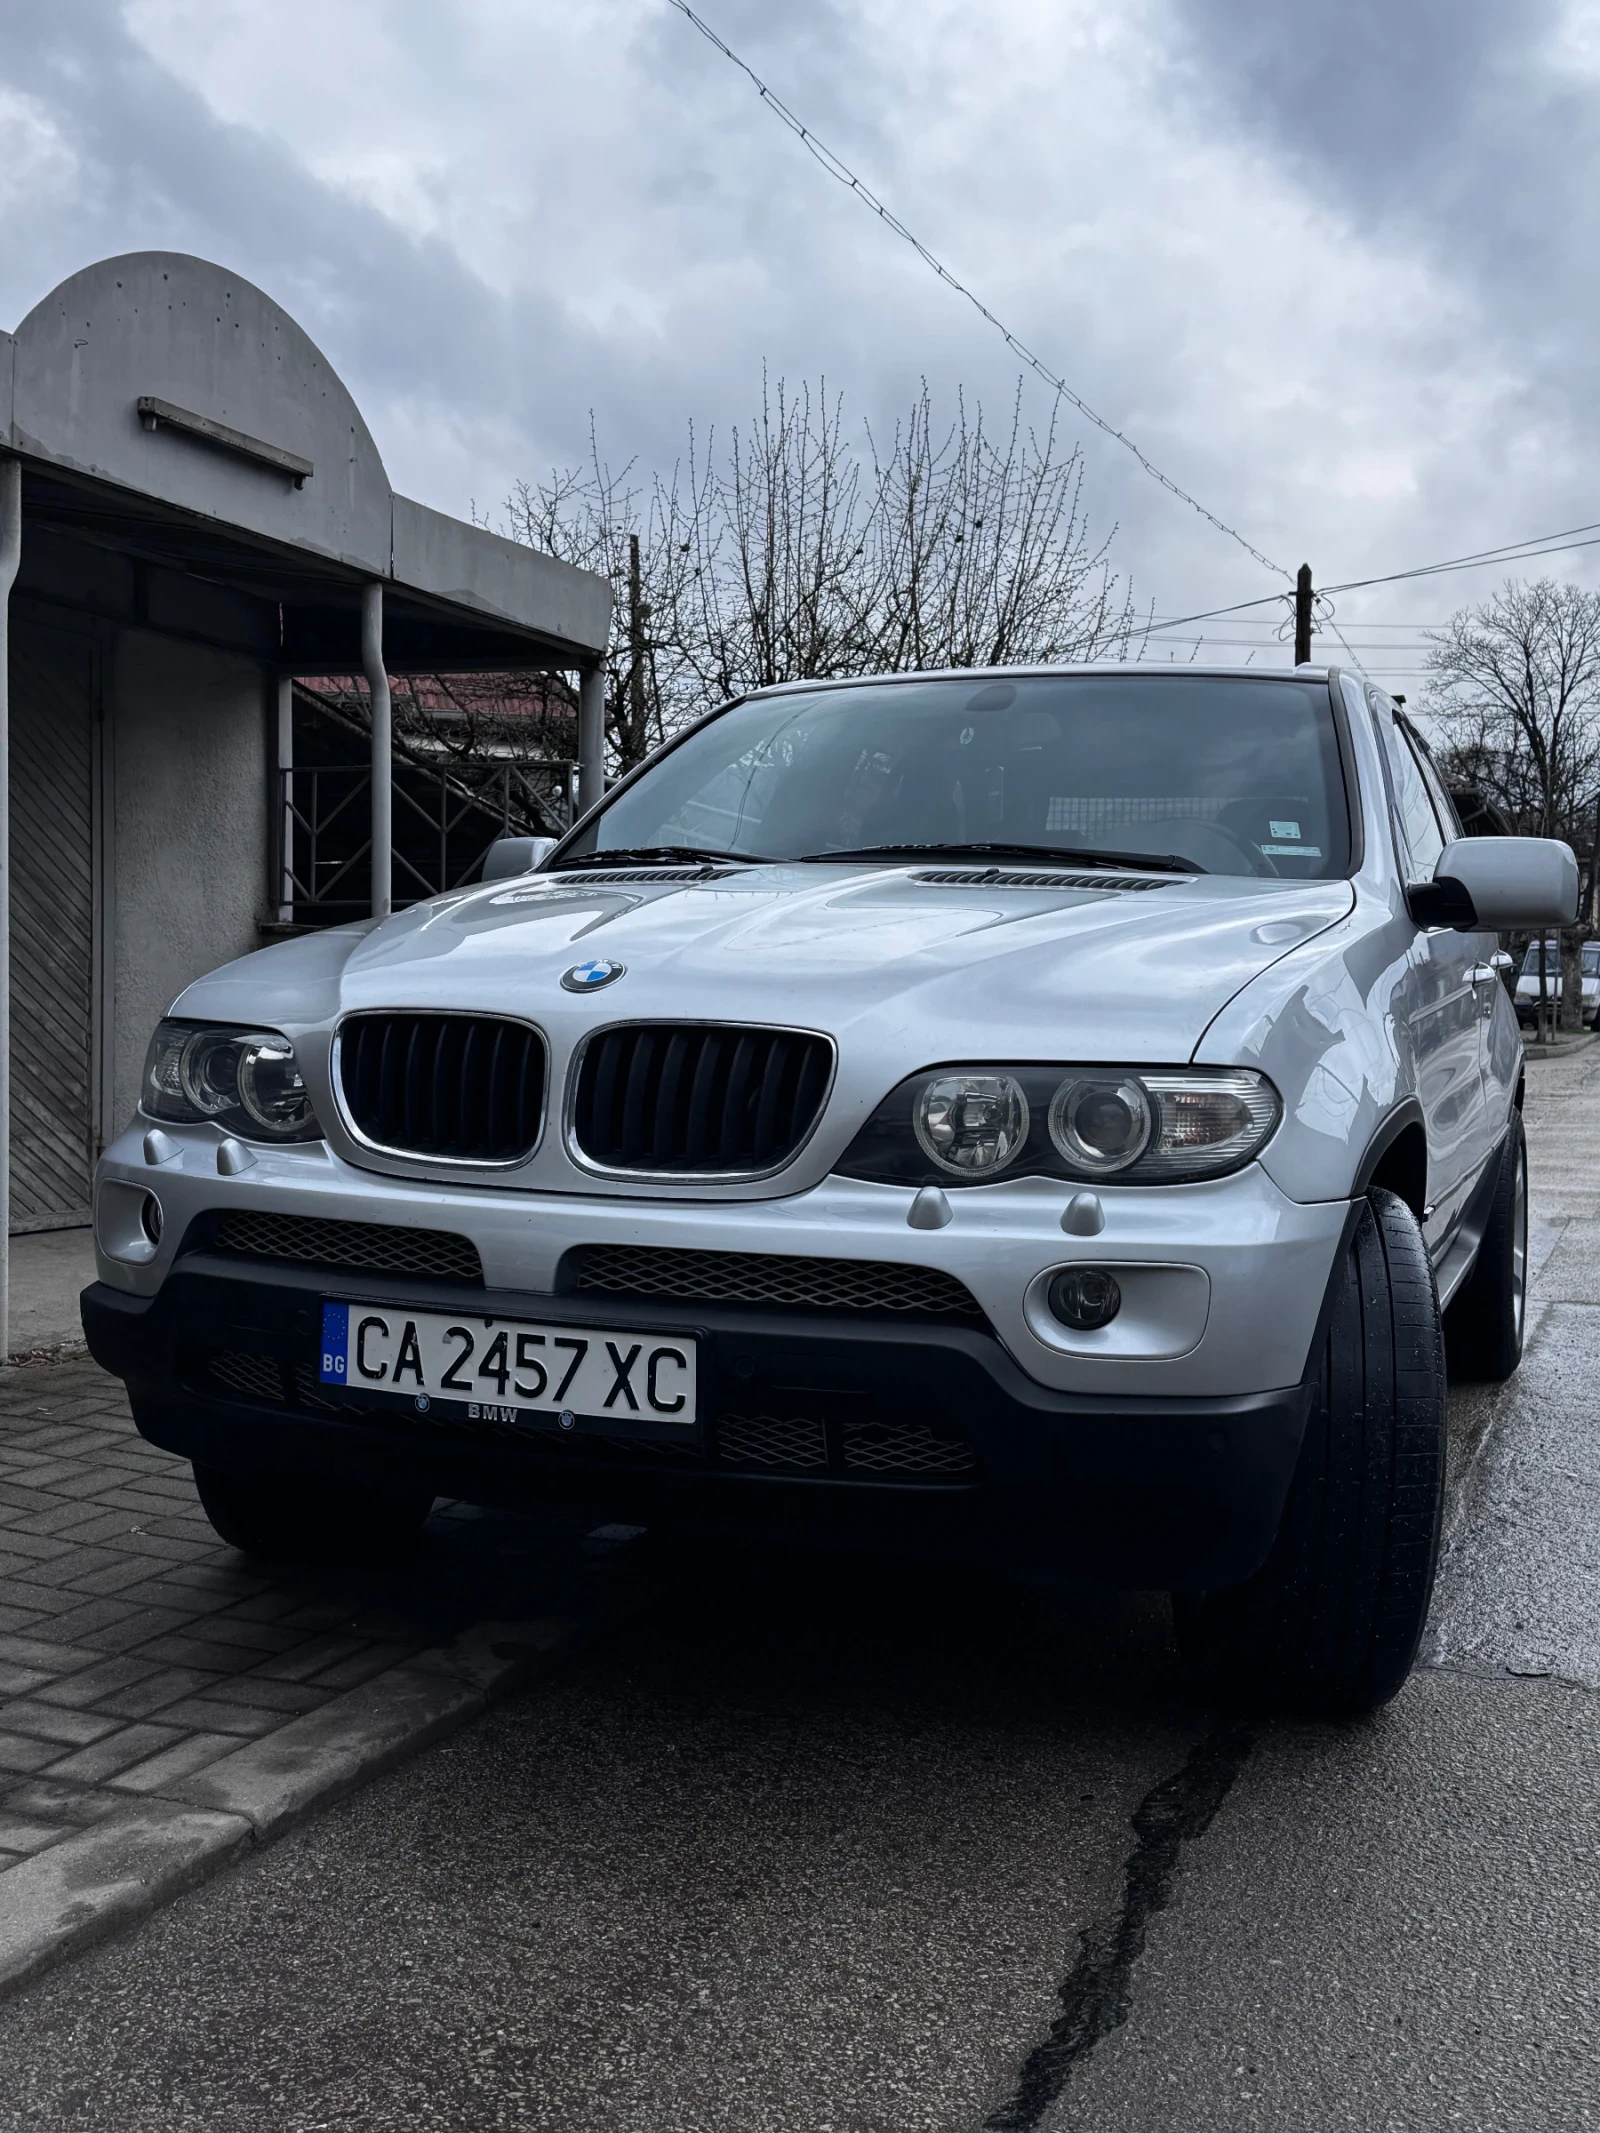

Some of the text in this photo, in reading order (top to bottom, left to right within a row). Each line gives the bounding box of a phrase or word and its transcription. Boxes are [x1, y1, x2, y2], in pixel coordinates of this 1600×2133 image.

[323, 1353, 345, 1374] BG
[356, 1316, 687, 1414] CA 2457 XC
[468, 1403, 519, 1424] BMW
